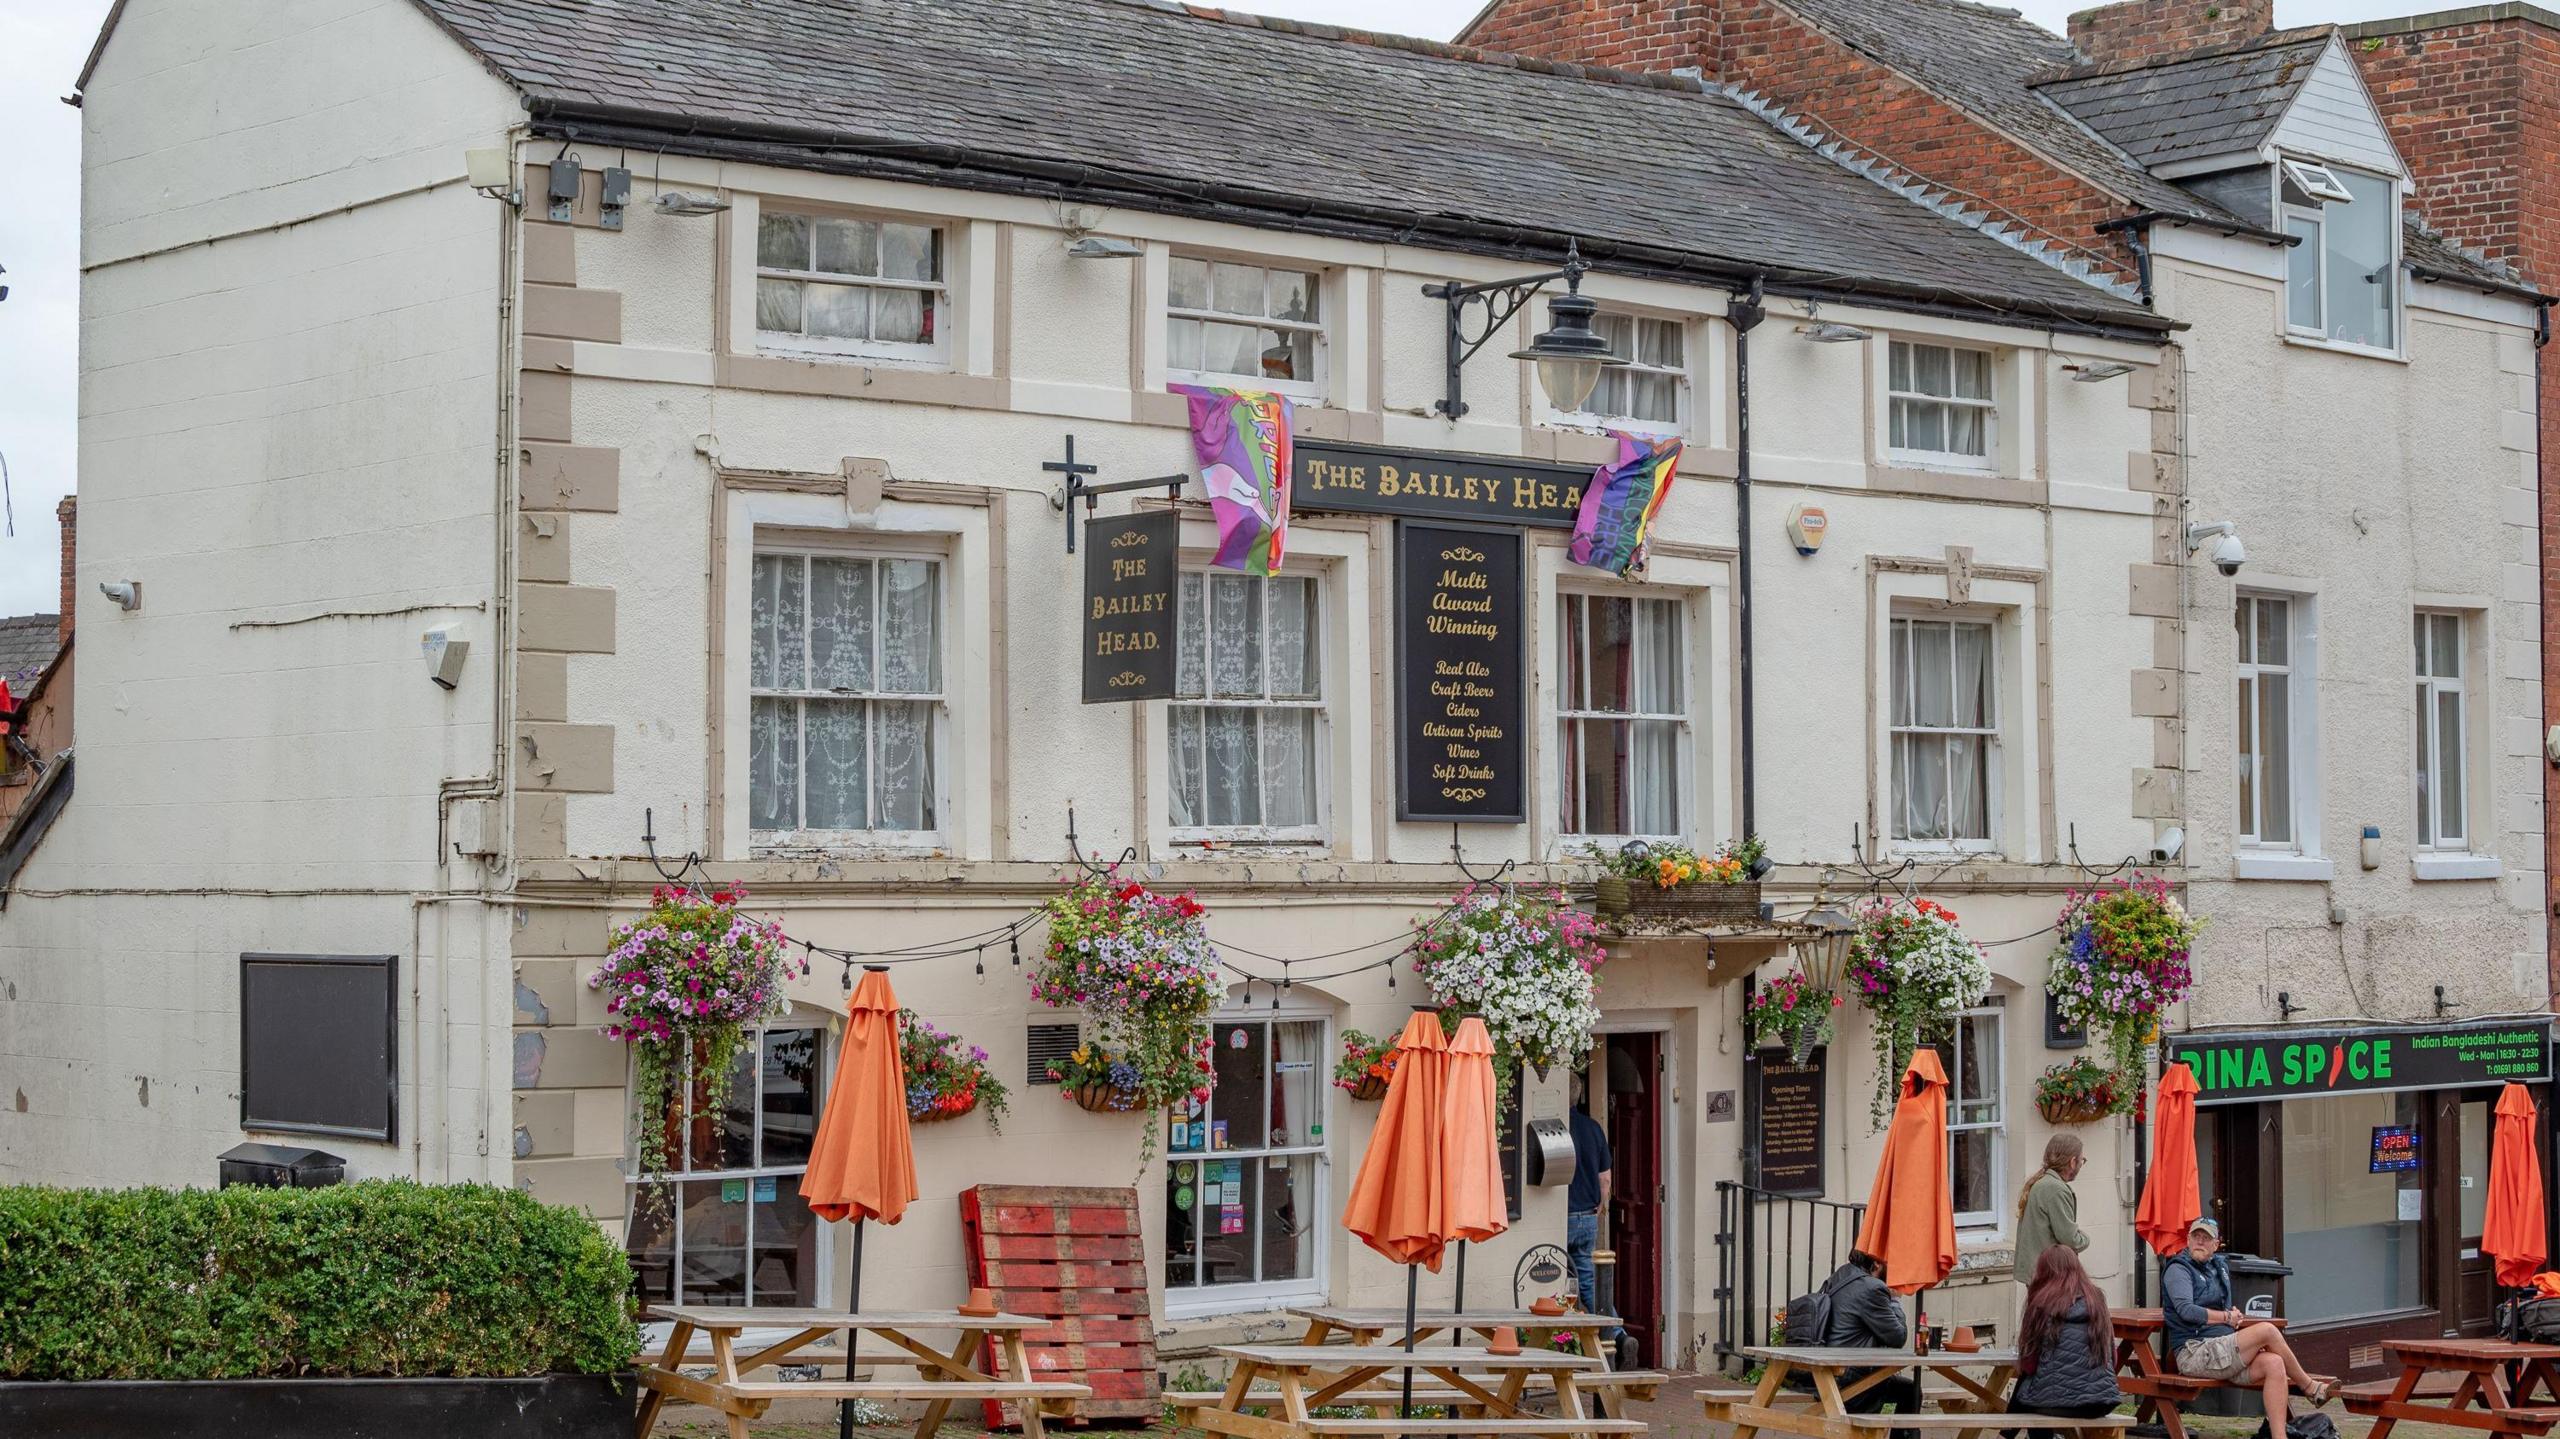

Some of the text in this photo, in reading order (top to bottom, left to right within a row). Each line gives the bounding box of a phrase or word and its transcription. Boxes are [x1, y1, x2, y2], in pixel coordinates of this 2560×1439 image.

[1308, 459, 1581, 509] THE BAILEY HEA
[1112, 558, 1147, 582] THE
[1436, 569, 1488, 589] Multi
[1091, 592, 1167, 620] BAILEY
[1432, 592, 1493, 612] Award
[1426, 615, 1499, 641] Winning
[1096, 631, 1160, 656] HEAD.
[1434, 660, 1490, 676] Real Ales
[1431, 680, 1494, 700] Craft Beers
[1446, 702, 1480, 717] Ciders
[1423, 722, 1503, 741] Artisan Spirits
[1446, 743, 1480, 758] Wines
[1432, 763, 1495, 782] Soft Drinks
[2412, 1030, 2539, 1049] Indian Bangladeshi Authentic
[2459, 1051, 2475, 1062] Wed
[2480, 1050, 2495, 1060] Mon
[2500, 1049, 2517, 1059] 16:30
[2521, 1048, 2539, 1058] 22:30
[2486, 1065, 2493, 1075] T:
[2494, 1064, 2511, 1074] 01691
[1771, 1085, 1811, 1095] Opening Times
[2383, 1136, 2410, 1149] OPEN
[2376, 1150, 2414, 1162] Welcome
